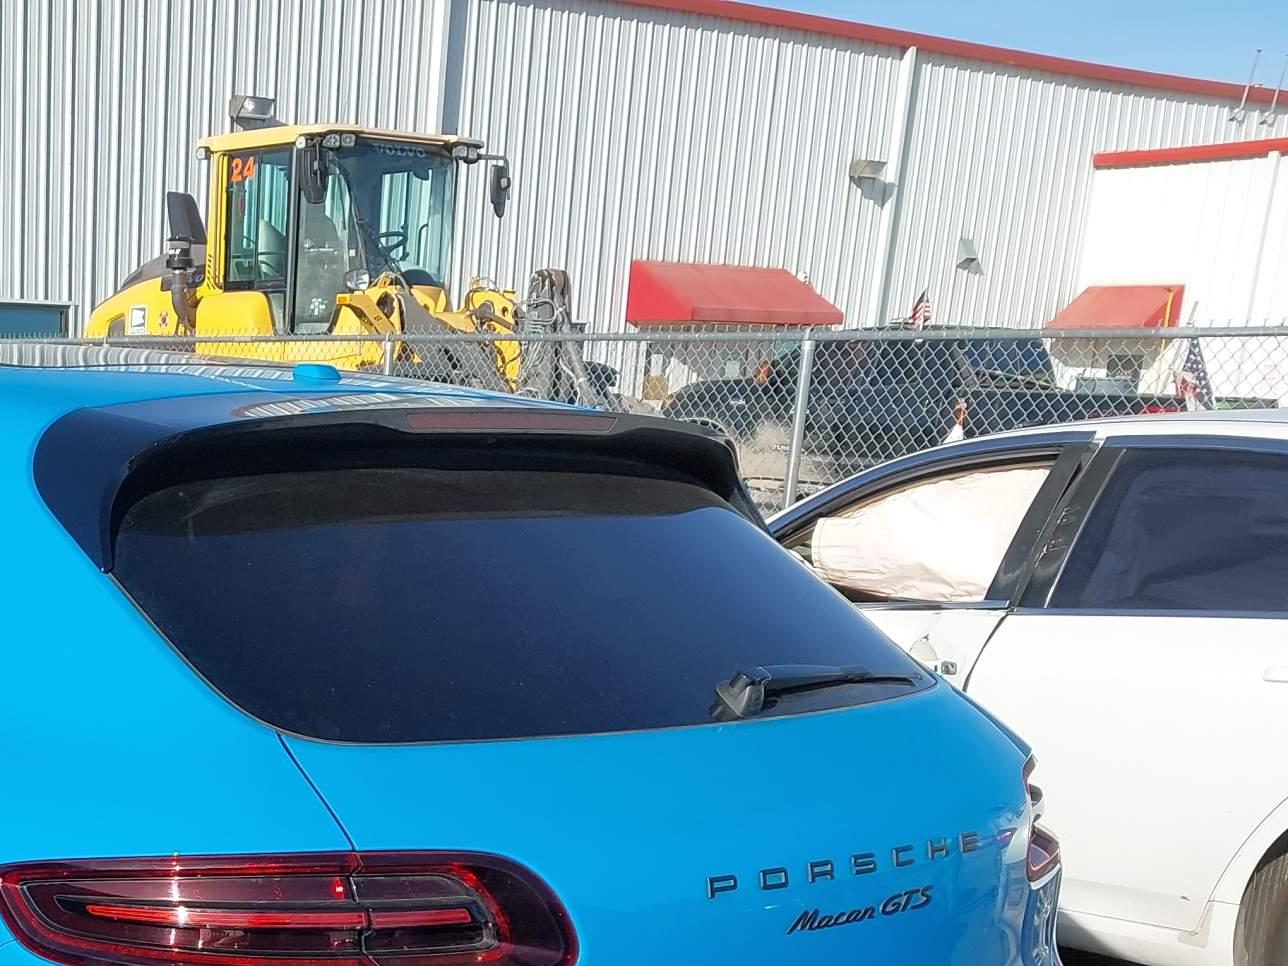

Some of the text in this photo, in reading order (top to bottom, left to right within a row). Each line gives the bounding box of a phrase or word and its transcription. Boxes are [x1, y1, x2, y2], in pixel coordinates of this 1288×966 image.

[231, 157, 255, 182] 24
[707, 831, 980, 899] PORSCHE
[786, 884, 934, 936] Macan GTS
